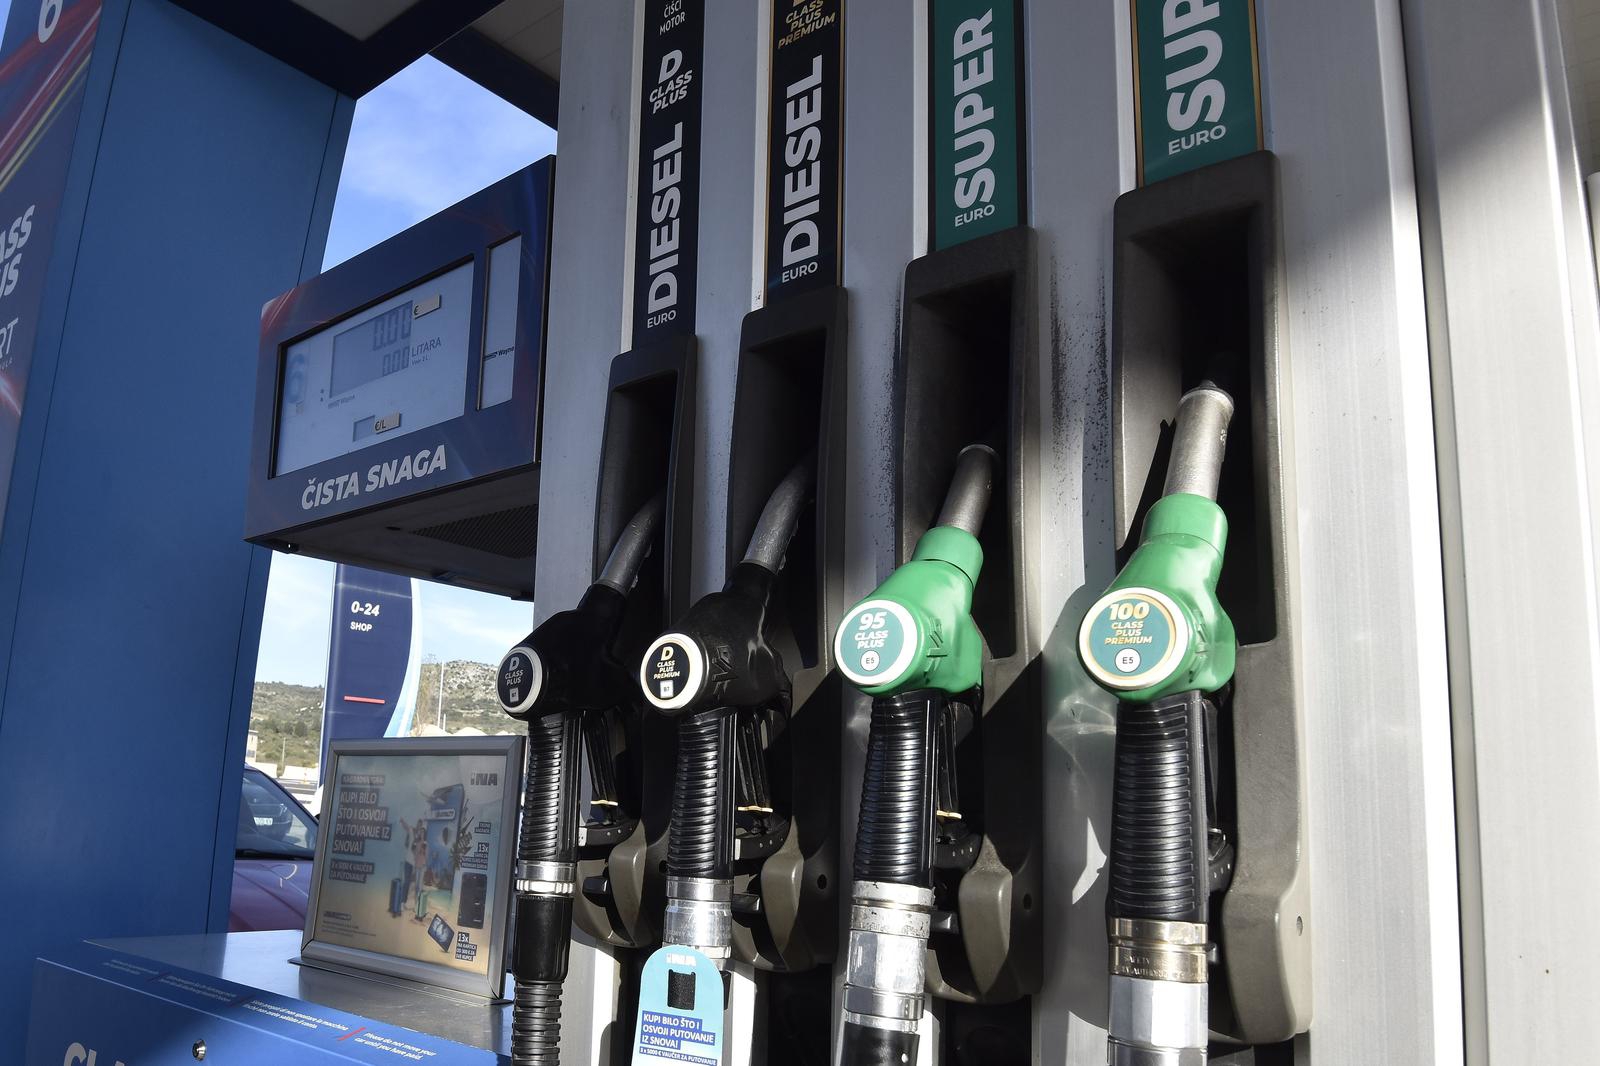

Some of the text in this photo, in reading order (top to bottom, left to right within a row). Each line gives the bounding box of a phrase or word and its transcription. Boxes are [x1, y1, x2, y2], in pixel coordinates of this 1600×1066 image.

[785, 0, 824, 24] CLASS
[790, 8, 822, 32] PLUS
[659, 11, 686, 36] MOTOR
[778, 12, 836, 49] PREMIUM
[658, 49, 683, 84] D
[649, 69, 693, 103] CLASS
[652, 85, 688, 114] PLUS
[953, 7, 996, 209] SUPER
[1167, 124, 1226, 156] EURO
[782, 54, 823, 268] DIESEL
[647, 121, 683, 315] DIESEL
[954, 204, 996, 227] EURO
[781, 261, 819, 283] EURO
[647, 309, 677, 329] EURO
[411, 336, 442, 357] LITARA
[301, 444, 447, 510] ČISTA SNAGA
[350, 600, 380, 616] 0-24
[1109, 601, 1150, 621] 100
[350, 621, 373, 632] SHOP
[858, 611, 888, 631] 95
[1111, 621, 1144, 630] CLASS
[854, 630, 889, 641] CLASS
[1104, 636, 1153, 645] PREMIUM
[1115, 628, 1142, 637] PLUS
[857, 639, 885, 650] PLUS
[661, 646, 674, 661] D
[1122, 656, 1134, 665] E5
[509, 656, 520, 671] D
[657, 660, 676, 668] CLASS
[659, 666, 674, 674] PLUS
[504, 669, 524, 680] CLASS
[506, 677, 522, 686] PLUS
[653, 671, 680, 680] PREMIUM
[470, 772, 498, 786] INA
[340, 791, 377, 805] KUPI BILO
[337, 804, 353, 819] ŠTO
[358, 808, 386, 822] OSVOJI
[335, 823, 390, 839] PUTOVANJE IZ
[333, 840, 363, 853] SNOVA!
[458, 933, 469, 943] 13x
[643, 1013, 700, 1029] KUPI BILO ŠTO I
[642, 1024, 714, 1043] OSVOJI PUTOVANJE
[363, 1032, 385, 1041] Please
[403, 1044, 420, 1052] move
[417, 1048, 437, 1057] your
[378, 1044, 391, 1052] you
[390, 1046, 407, 1055] have
[641, 1035, 679, 1049] IZ SNOVA!
[661, 1049, 681, 1060] VAUČER
[688, 1055, 717, 1066] PUTOVANJE
